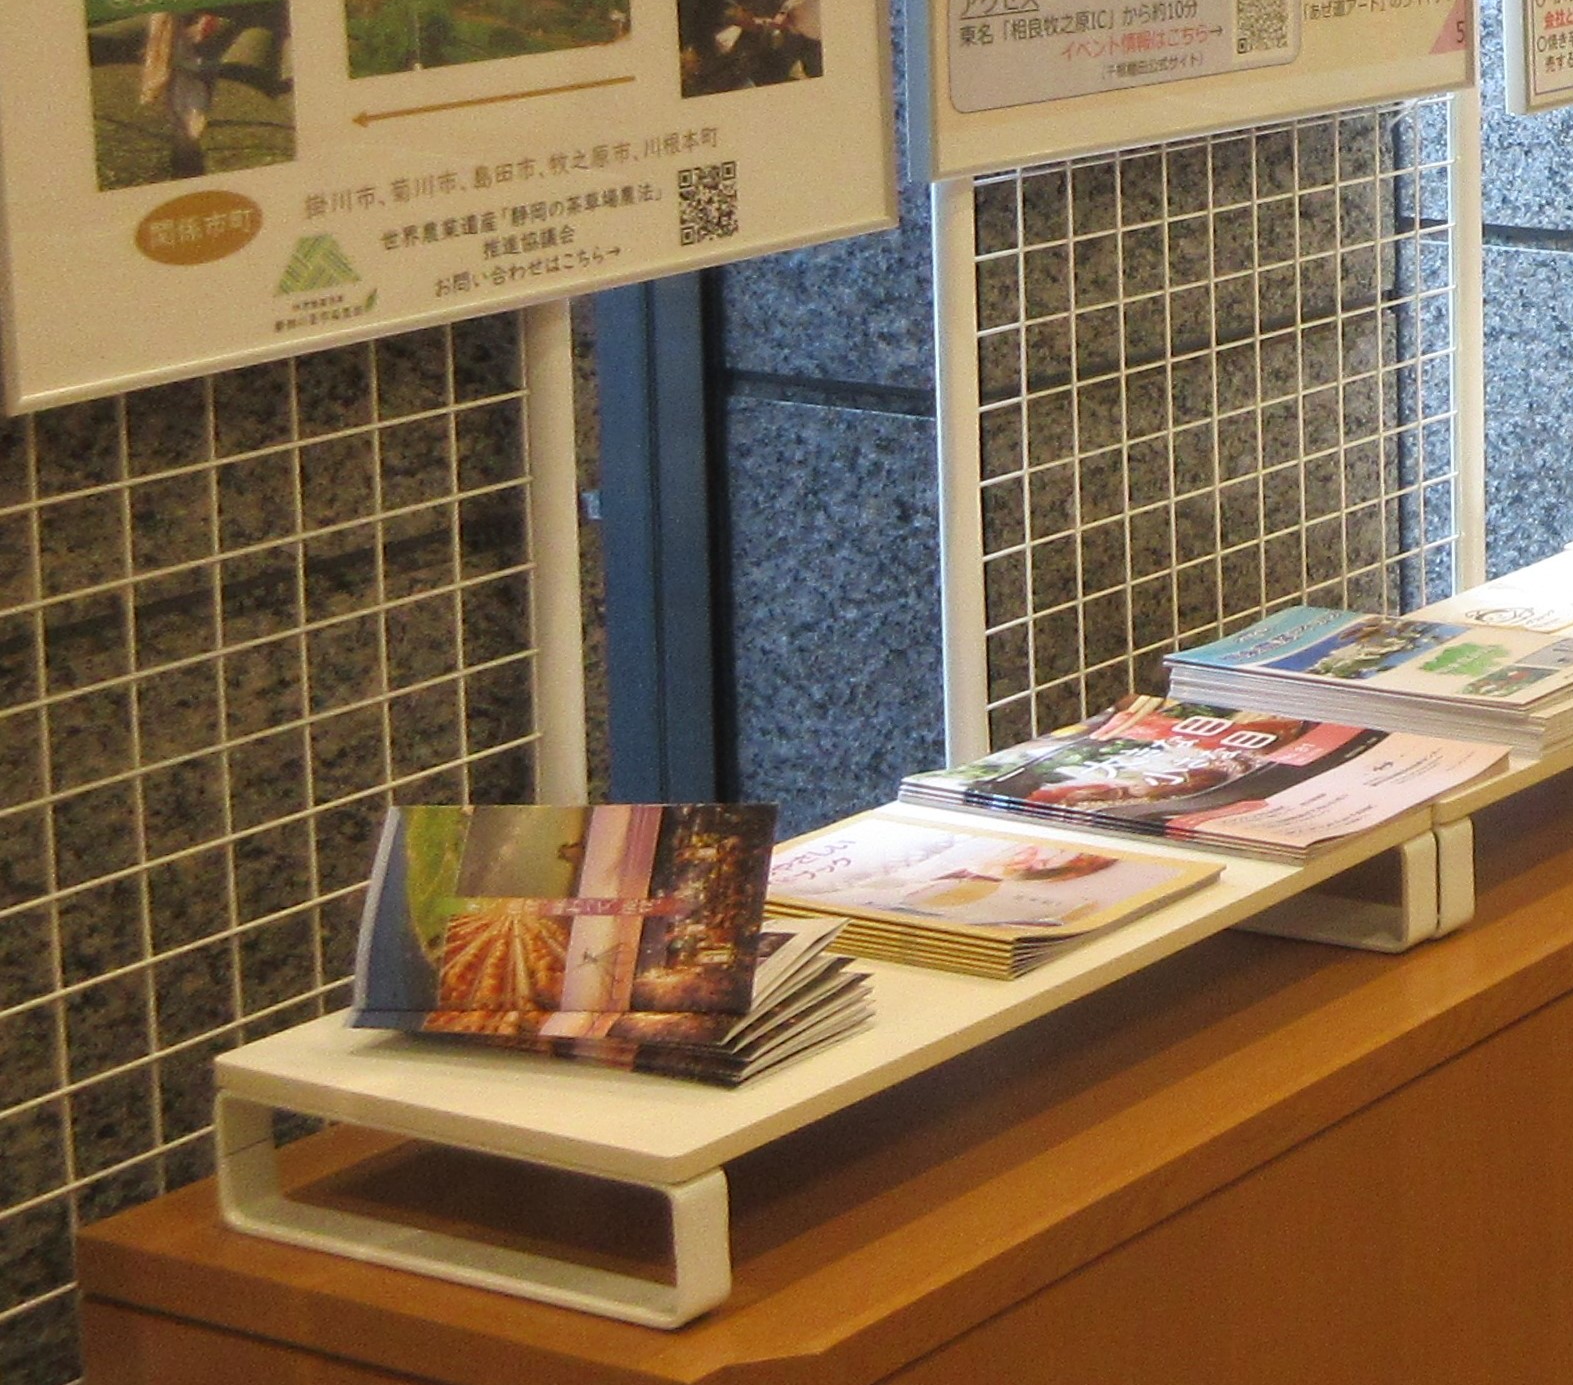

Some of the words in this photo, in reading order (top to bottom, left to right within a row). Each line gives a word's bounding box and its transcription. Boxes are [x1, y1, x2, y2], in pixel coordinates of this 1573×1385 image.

[1456, 20, 1465, 44] 5
[483, 225, 576, 260] 推進協議会
